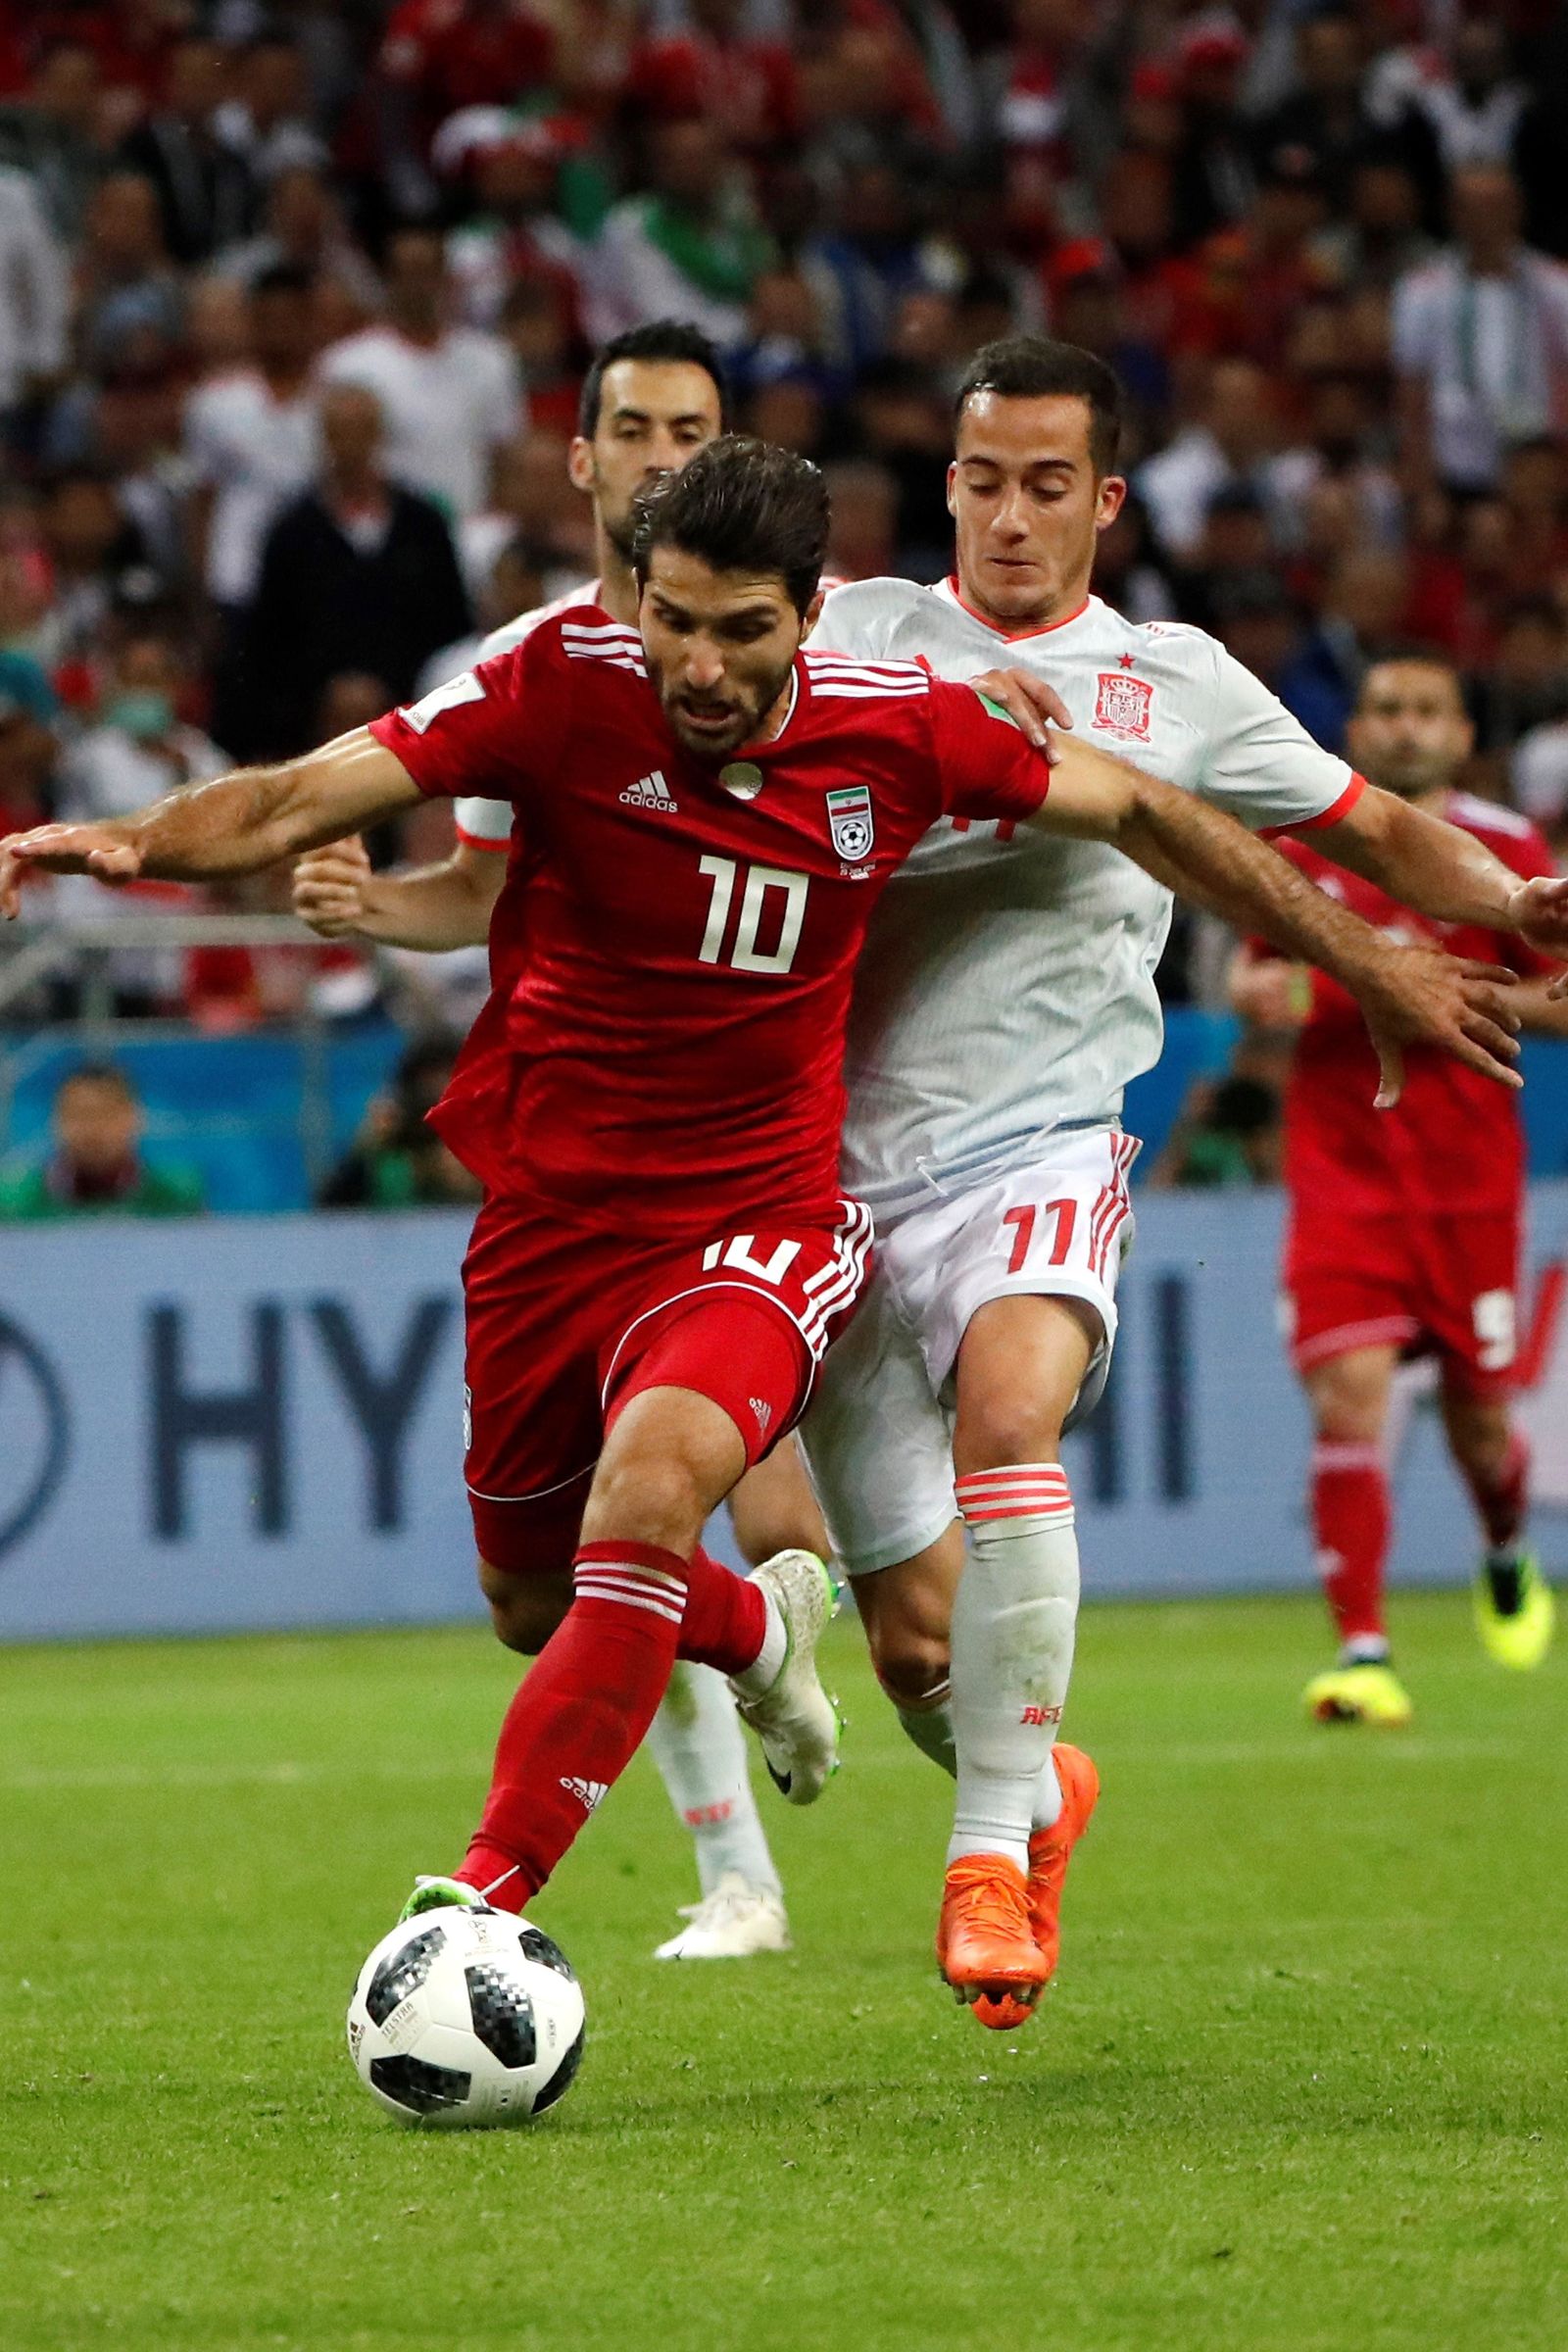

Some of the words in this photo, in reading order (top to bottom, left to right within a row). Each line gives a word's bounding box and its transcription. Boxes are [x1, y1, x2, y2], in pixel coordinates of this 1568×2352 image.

[618, 791, 678, 812] adidas
[698, 854, 810, 974] 10
[1003, 1198, 1078, 1274] 11
[1472, 1288, 1516, 1370] 9
